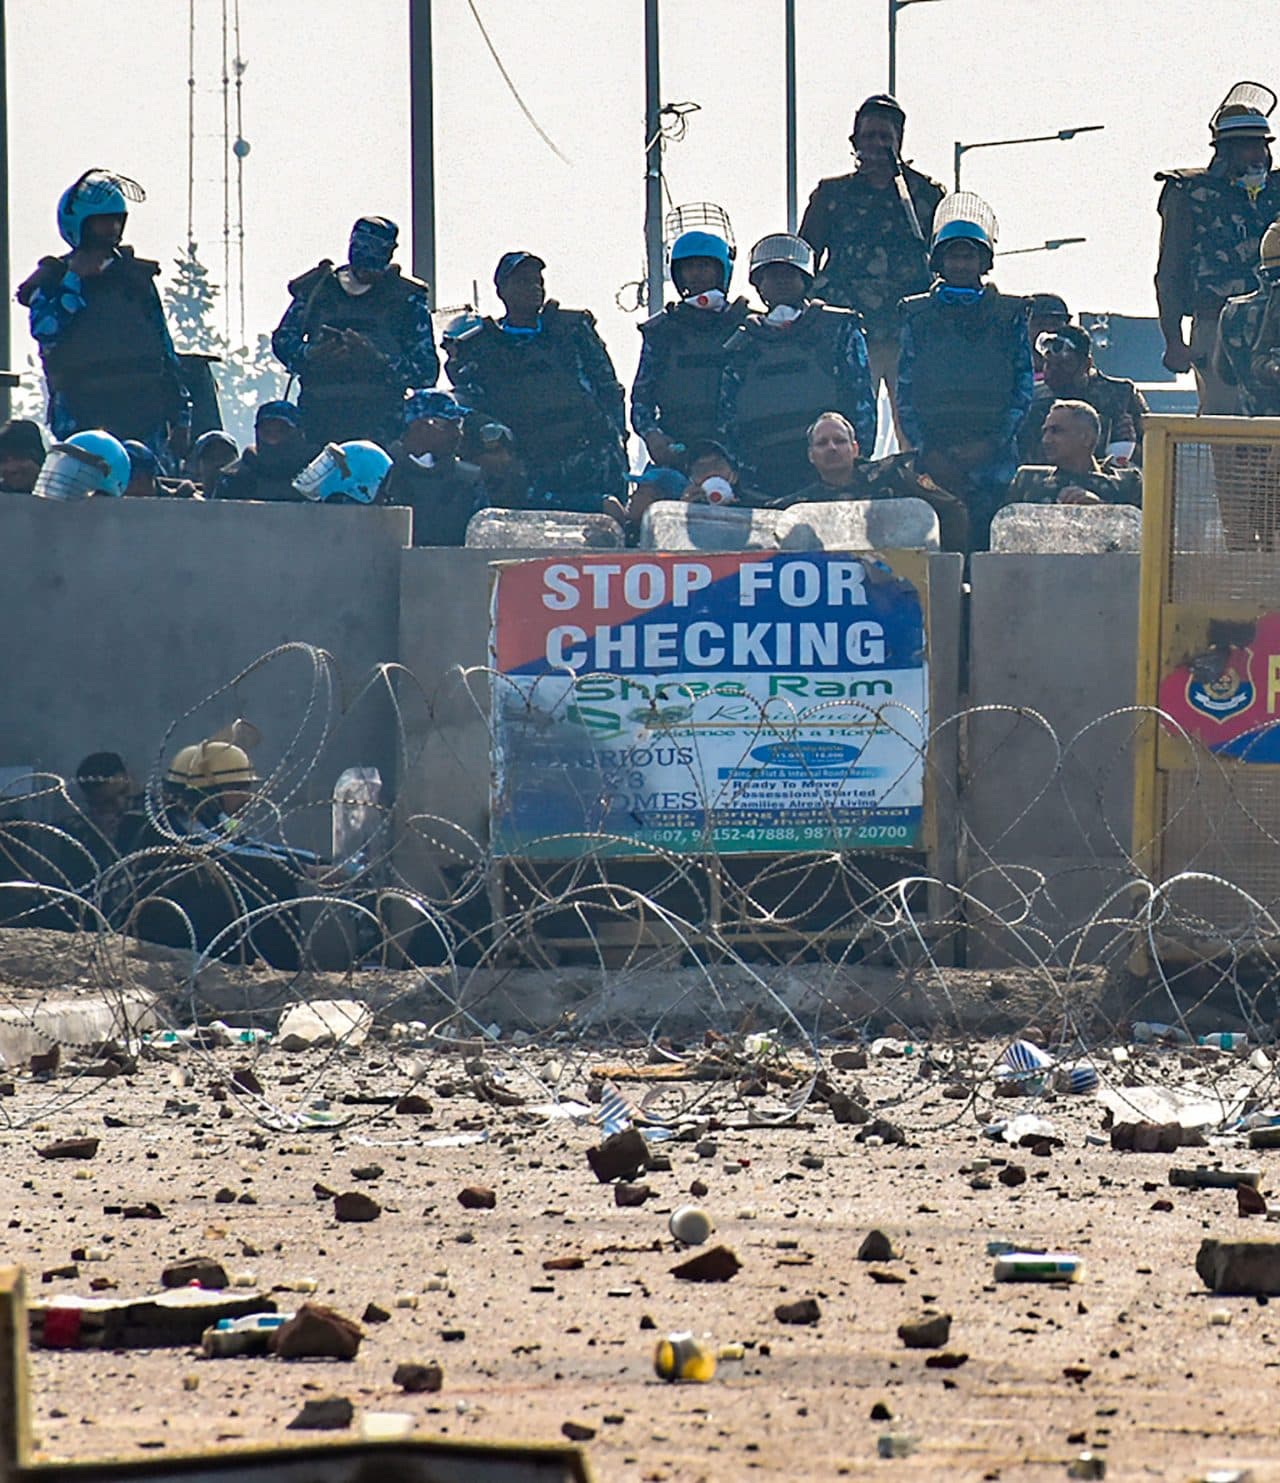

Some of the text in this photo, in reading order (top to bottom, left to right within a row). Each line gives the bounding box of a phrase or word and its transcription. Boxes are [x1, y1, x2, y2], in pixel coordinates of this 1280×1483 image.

[541, 561, 868, 610] STOP FOR
[546, 620, 885, 669] CHECKING
[575, 674, 893, 701] Shree Ram
[578, 747, 694, 769] URIOUS
[733, 780, 839, 791] Ready To Move
[824, 789, 876, 798] Started
[610, 791, 698, 810] OMES
[733, 800, 787, 809] Families
[692, 828, 800, 842] 9152-47888,
